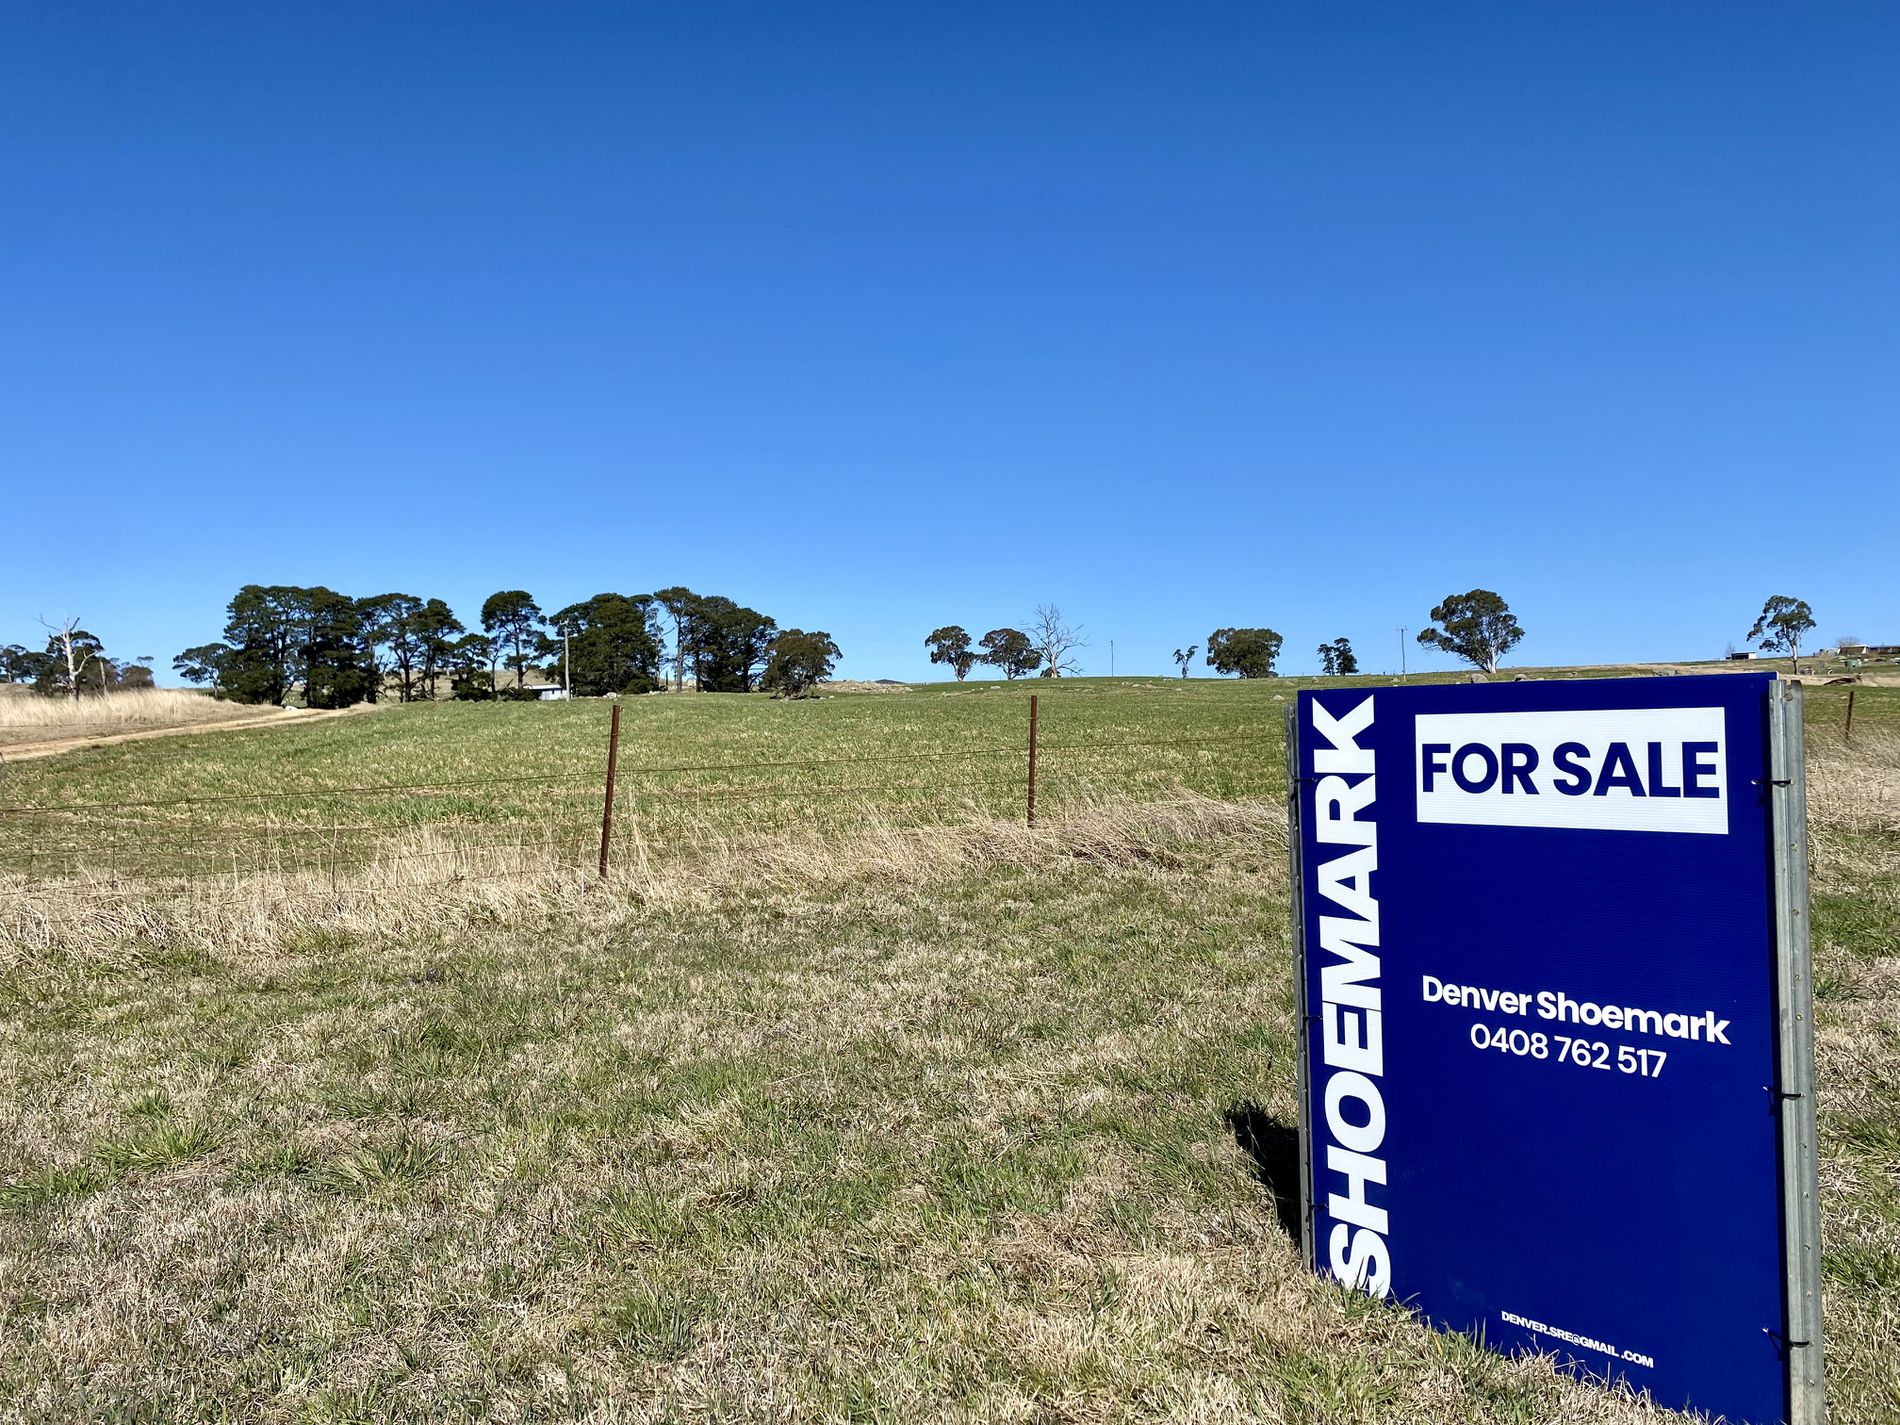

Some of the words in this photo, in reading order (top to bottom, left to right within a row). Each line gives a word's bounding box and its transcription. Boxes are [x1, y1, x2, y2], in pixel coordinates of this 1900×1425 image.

[1421, 742, 1540, 795] FOR
[1552, 741, 1720, 799] SALE
[1312, 694, 1391, 1300] SHOEMARK
[1422, 975, 1533, 1016] Denver
[1536, 990, 1732, 1046] Shoemark
[1470, 1023, 1549, 1060] 0408
[1554, 1035, 1611, 1070] 762
[1617, 1045, 1668, 1078] 517
